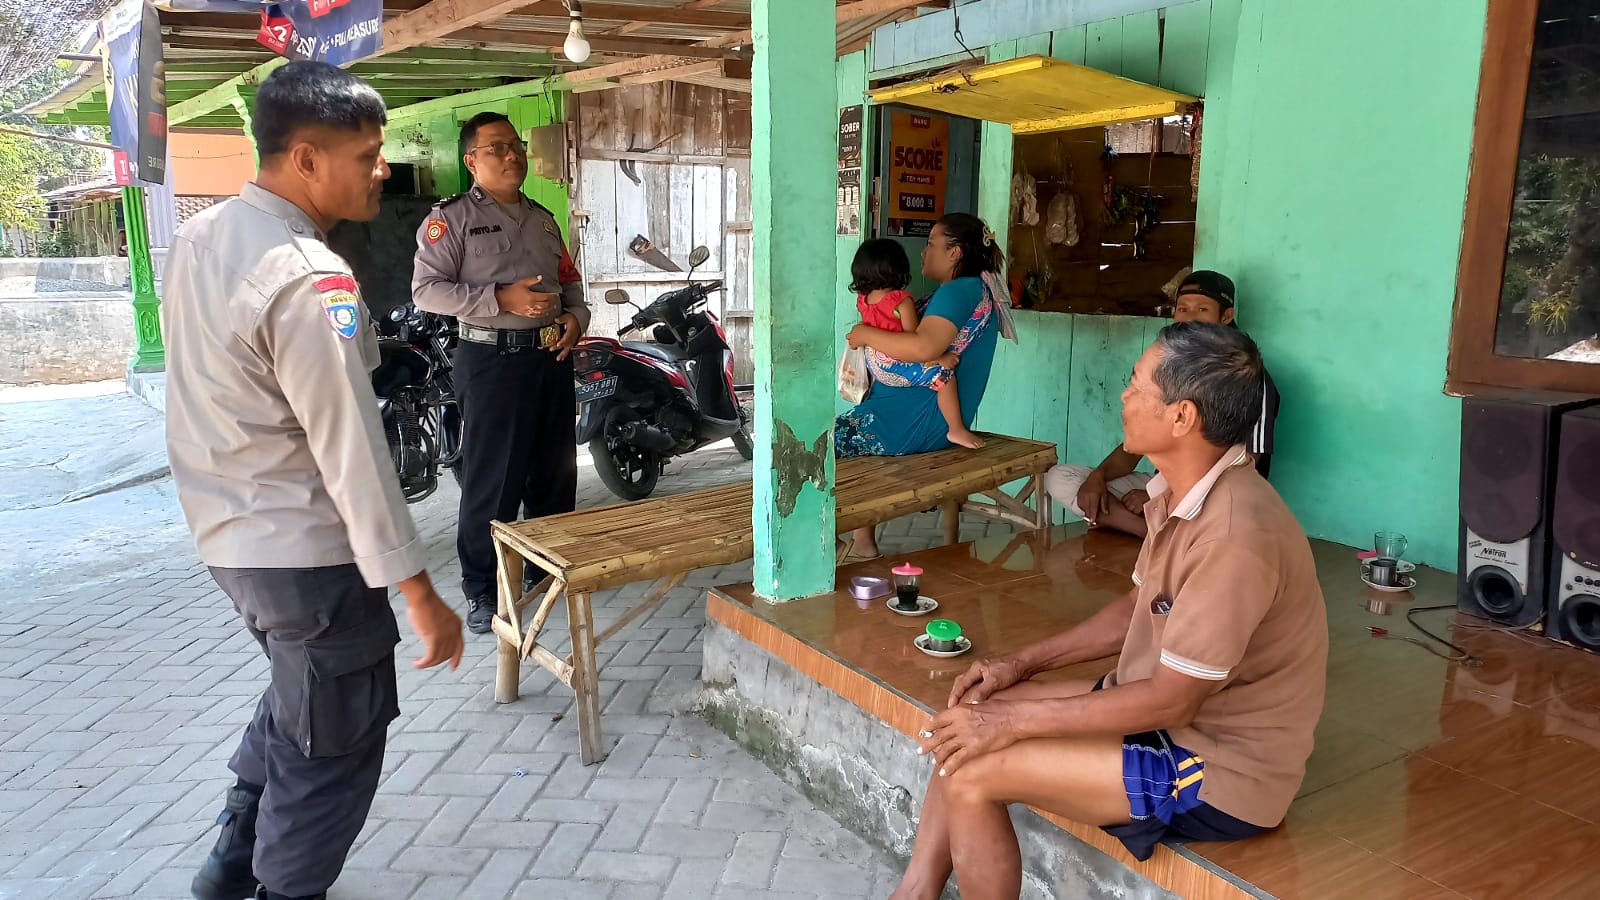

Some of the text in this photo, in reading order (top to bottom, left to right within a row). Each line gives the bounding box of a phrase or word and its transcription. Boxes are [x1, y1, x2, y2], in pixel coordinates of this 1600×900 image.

[840, 121, 860, 134] SOBER
[894, 145, 944, 171] SCORE
[906, 196, 925, 208] 8.000
